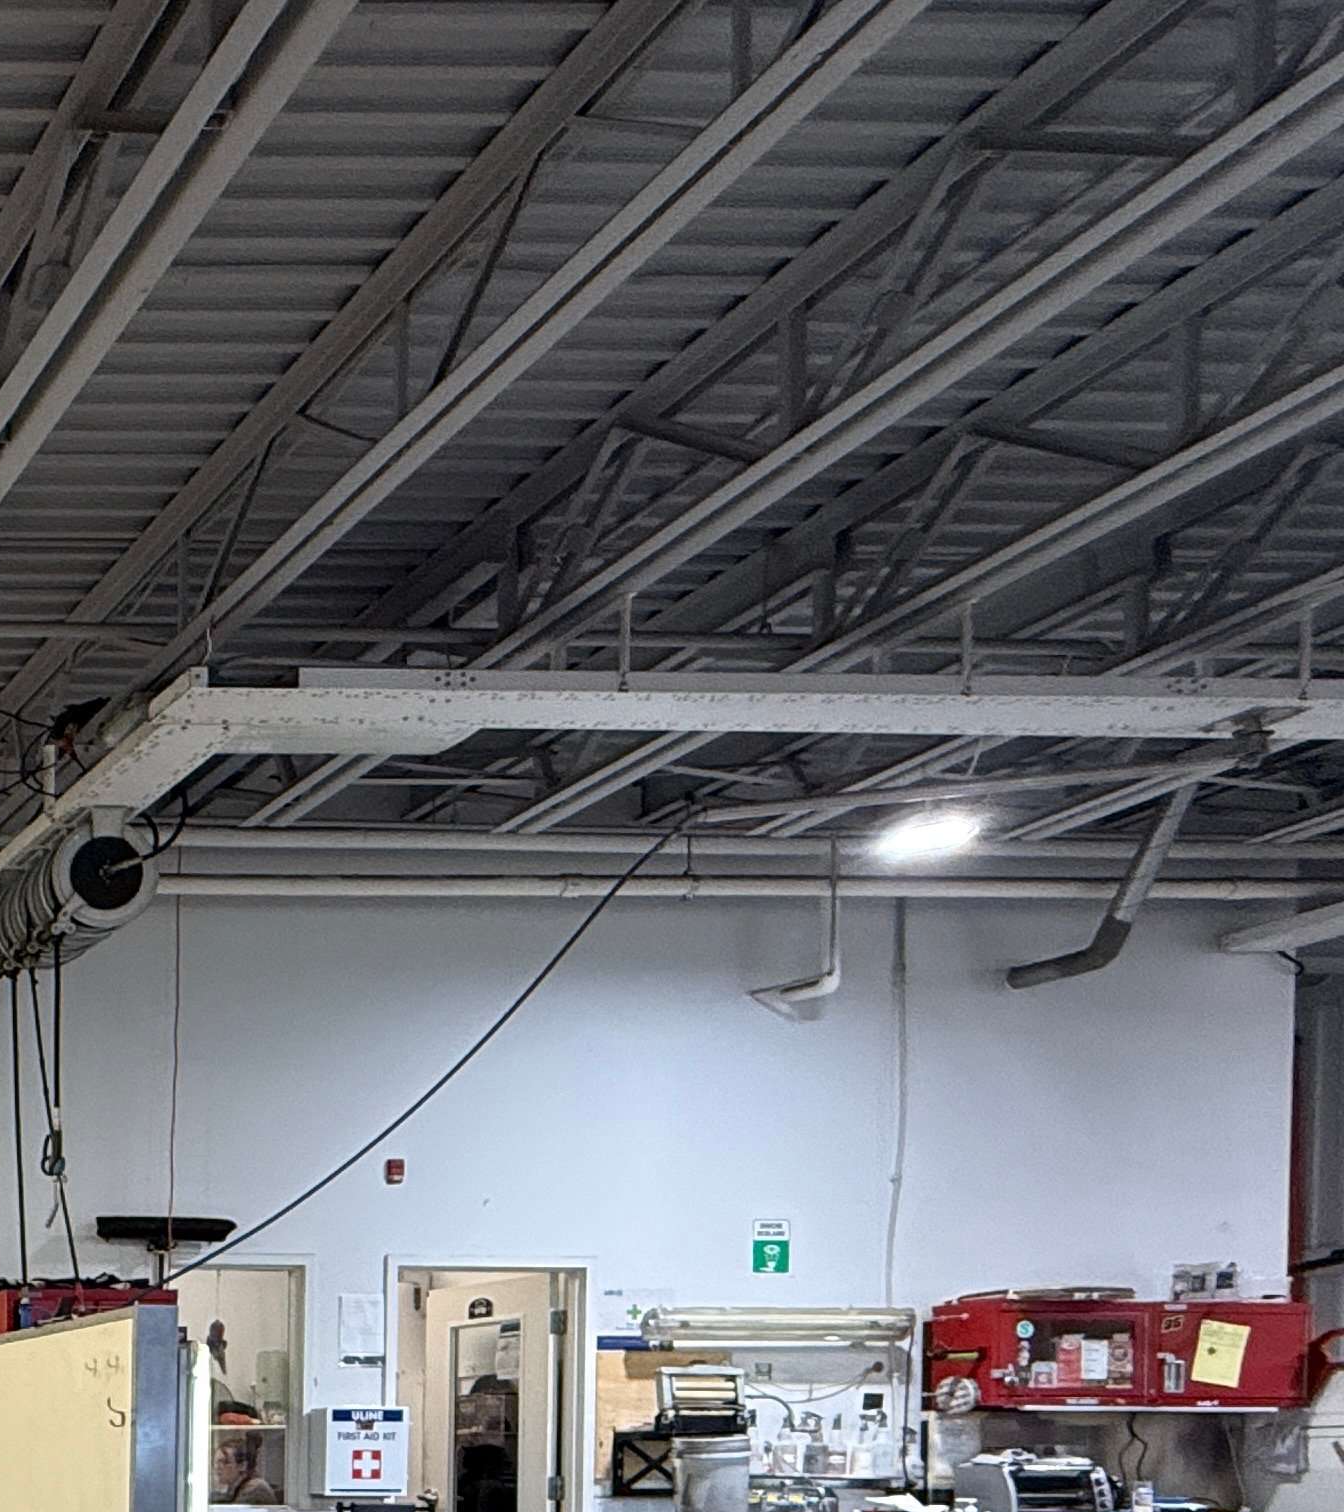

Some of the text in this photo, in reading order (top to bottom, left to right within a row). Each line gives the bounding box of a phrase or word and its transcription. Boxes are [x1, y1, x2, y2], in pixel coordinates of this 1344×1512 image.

[337, 1431, 397, 1441] FIRST AID KIT
